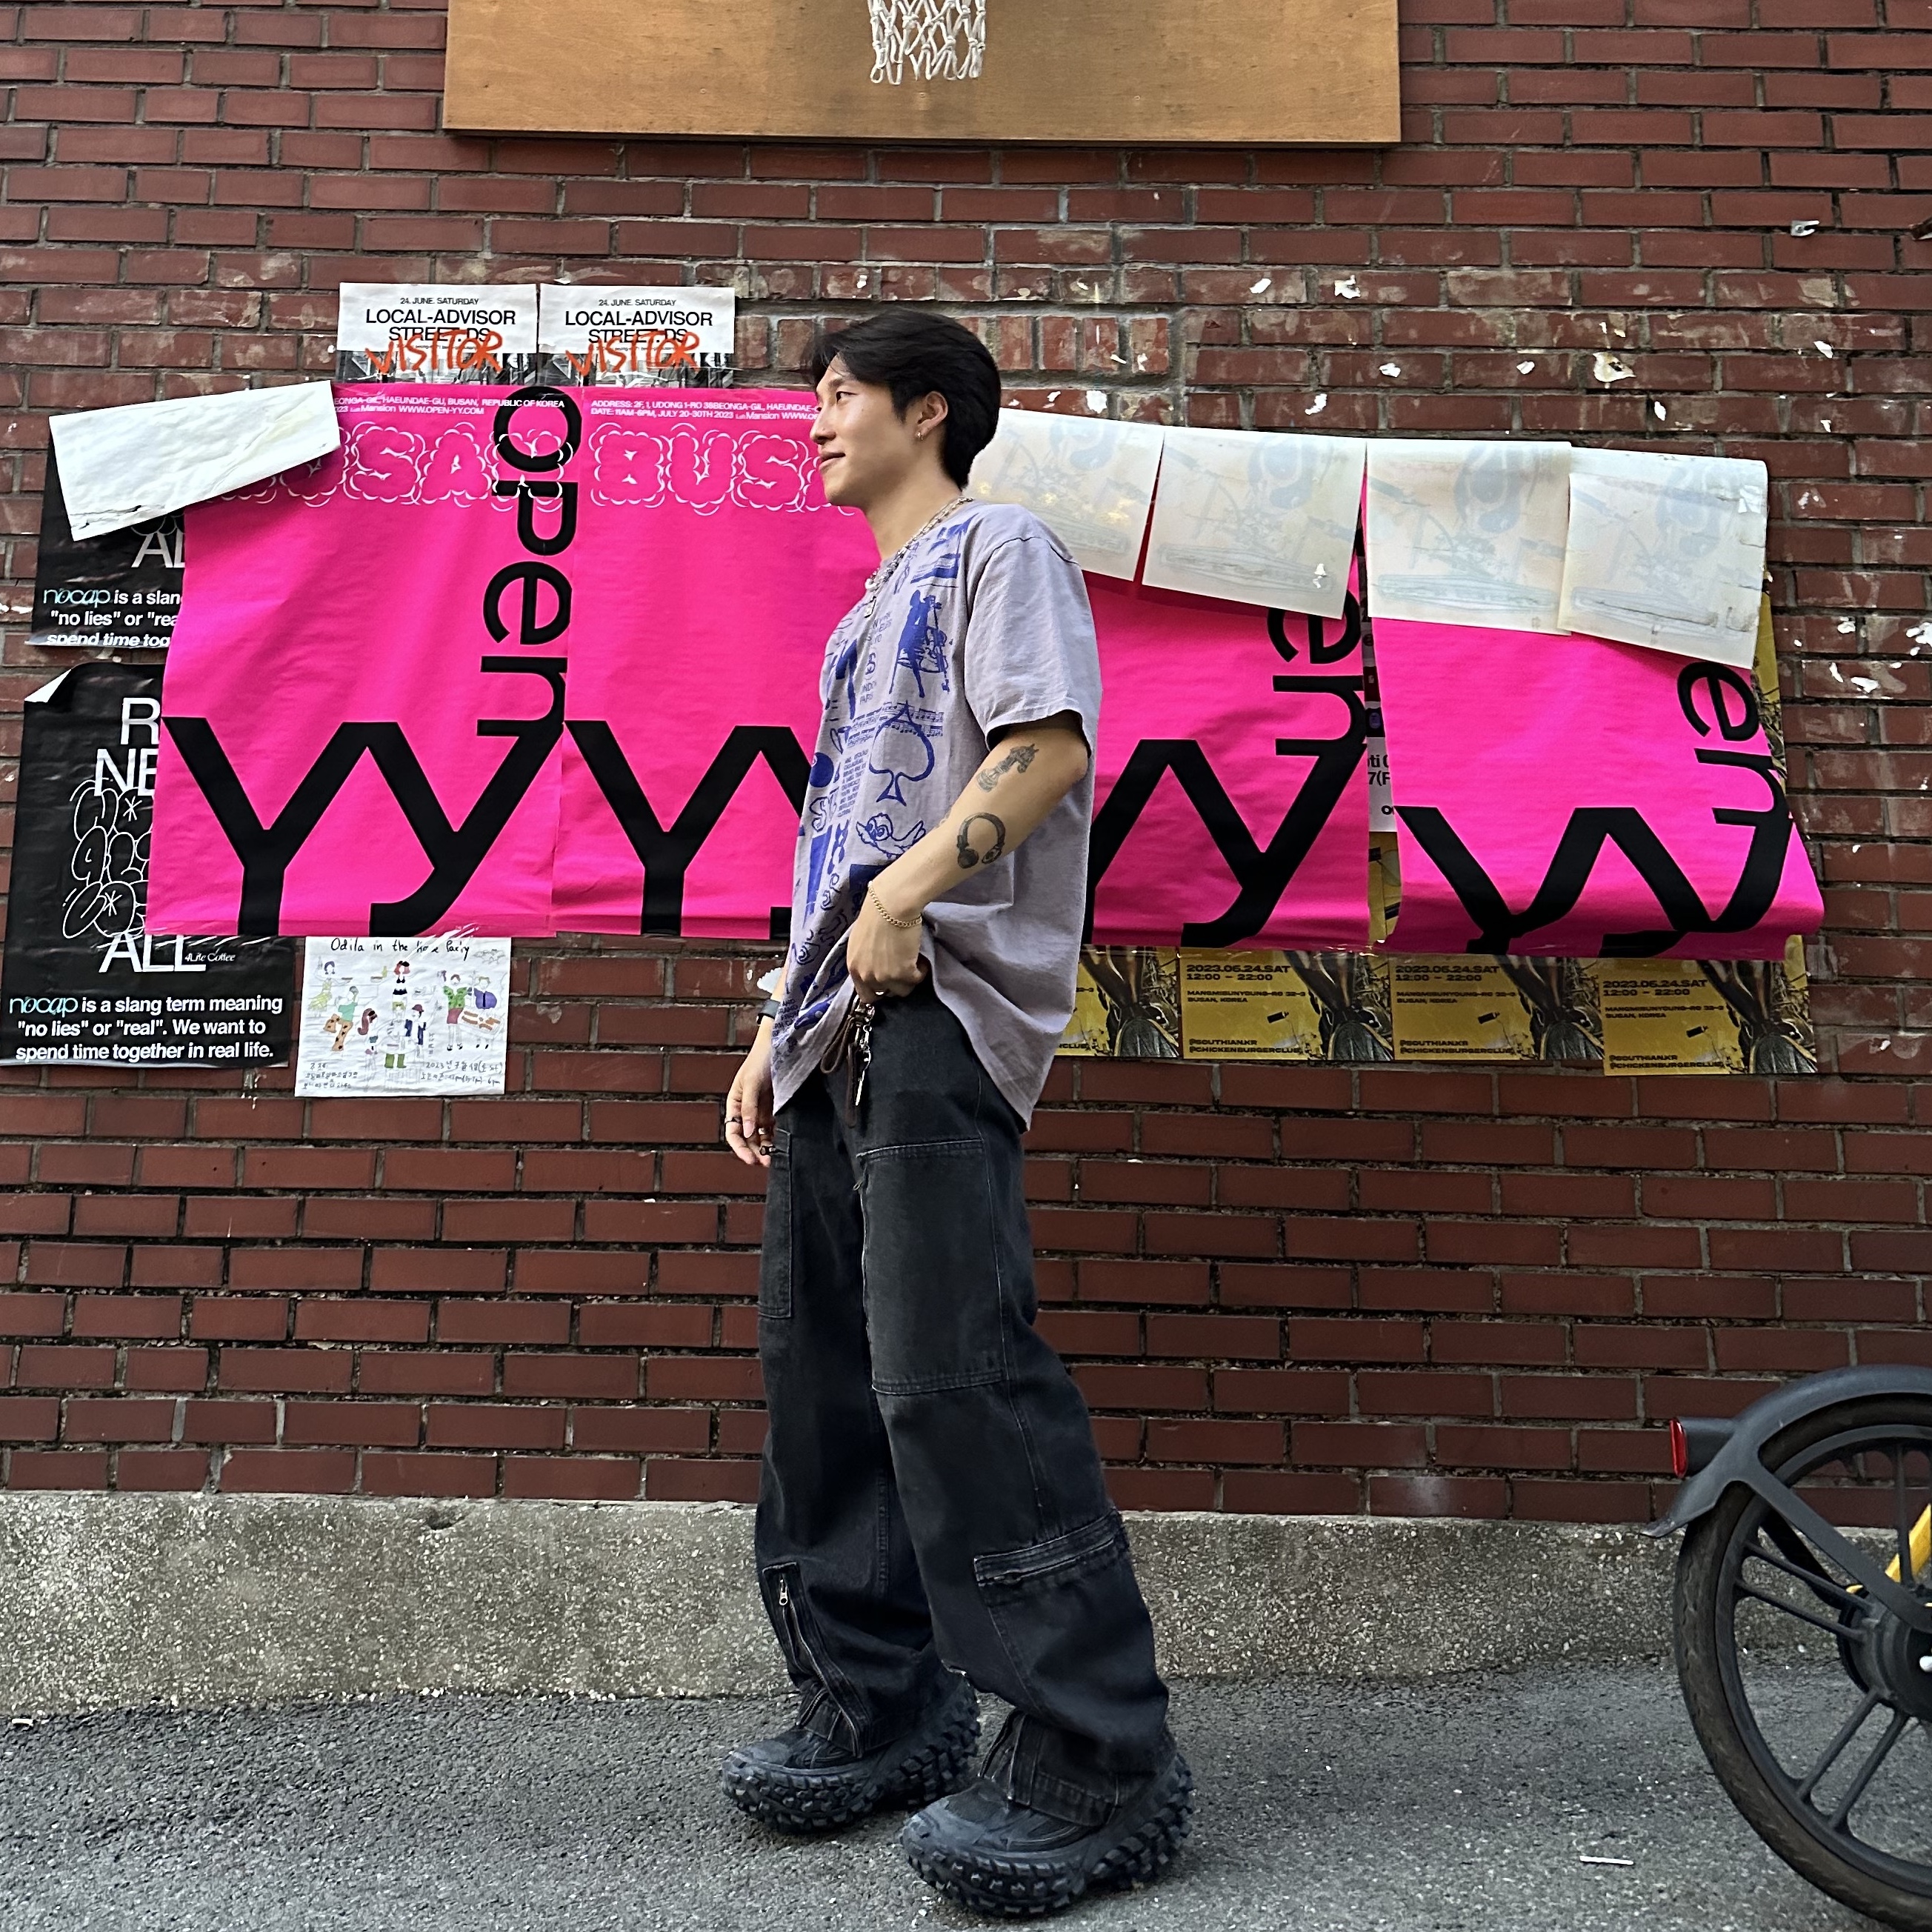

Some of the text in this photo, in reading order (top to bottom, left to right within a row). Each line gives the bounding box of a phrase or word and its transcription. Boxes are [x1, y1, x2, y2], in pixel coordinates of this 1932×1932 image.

[366, 309, 516, 324] LOCAL-ADVISOR
[565, 311, 713, 326] LOCAL-ADVISOR
[364, 329, 503, 373] VISITOR
[565, 330, 700, 376] VISITOR
[482, 399, 522, 407] REPUBLIC
[590, 400, 632, 408] ADDRESS:
[658, 410, 678, 418] JULY
[714, 410, 733, 419] 2023
[131, 533, 185, 568] AL
[43, 588, 183, 608] nocap is a slan
[50, 610, 179, 627] "no lies" or "rea
[47, 633, 170, 647] spend time tog
[330, 937, 364, 952] Odila
[373, 940, 383, 952] in
[393, 939, 408, 952] the
[99, 934, 206, 973] ALL
[9, 995, 283, 1018] nocap is a slang term meaning
[18, 1019, 266, 1036] "no lies" or "real". We want to
[16, 1042, 274, 1062] spend time together in real life.
